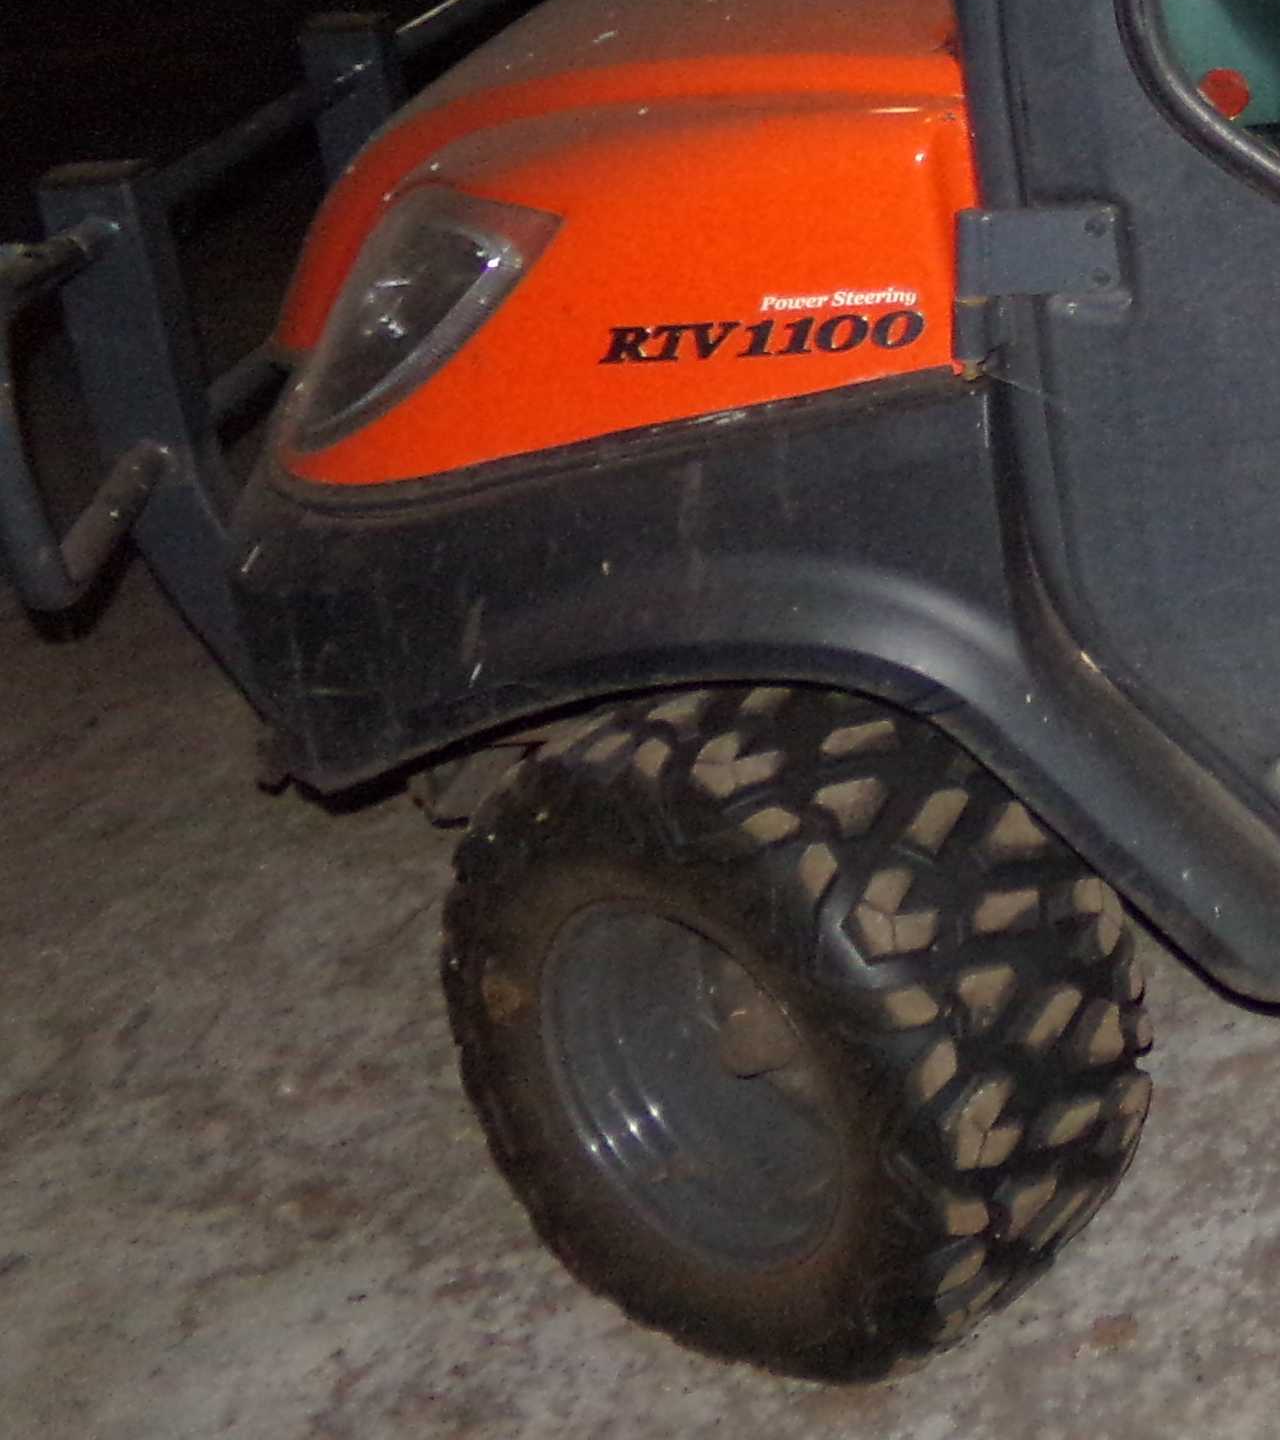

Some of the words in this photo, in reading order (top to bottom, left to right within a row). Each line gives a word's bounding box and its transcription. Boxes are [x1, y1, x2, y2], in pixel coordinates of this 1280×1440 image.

[760, 295, 829, 311] Power
[831, 287, 917, 306] Steering
[598, 310, 926, 365] RTV1100
